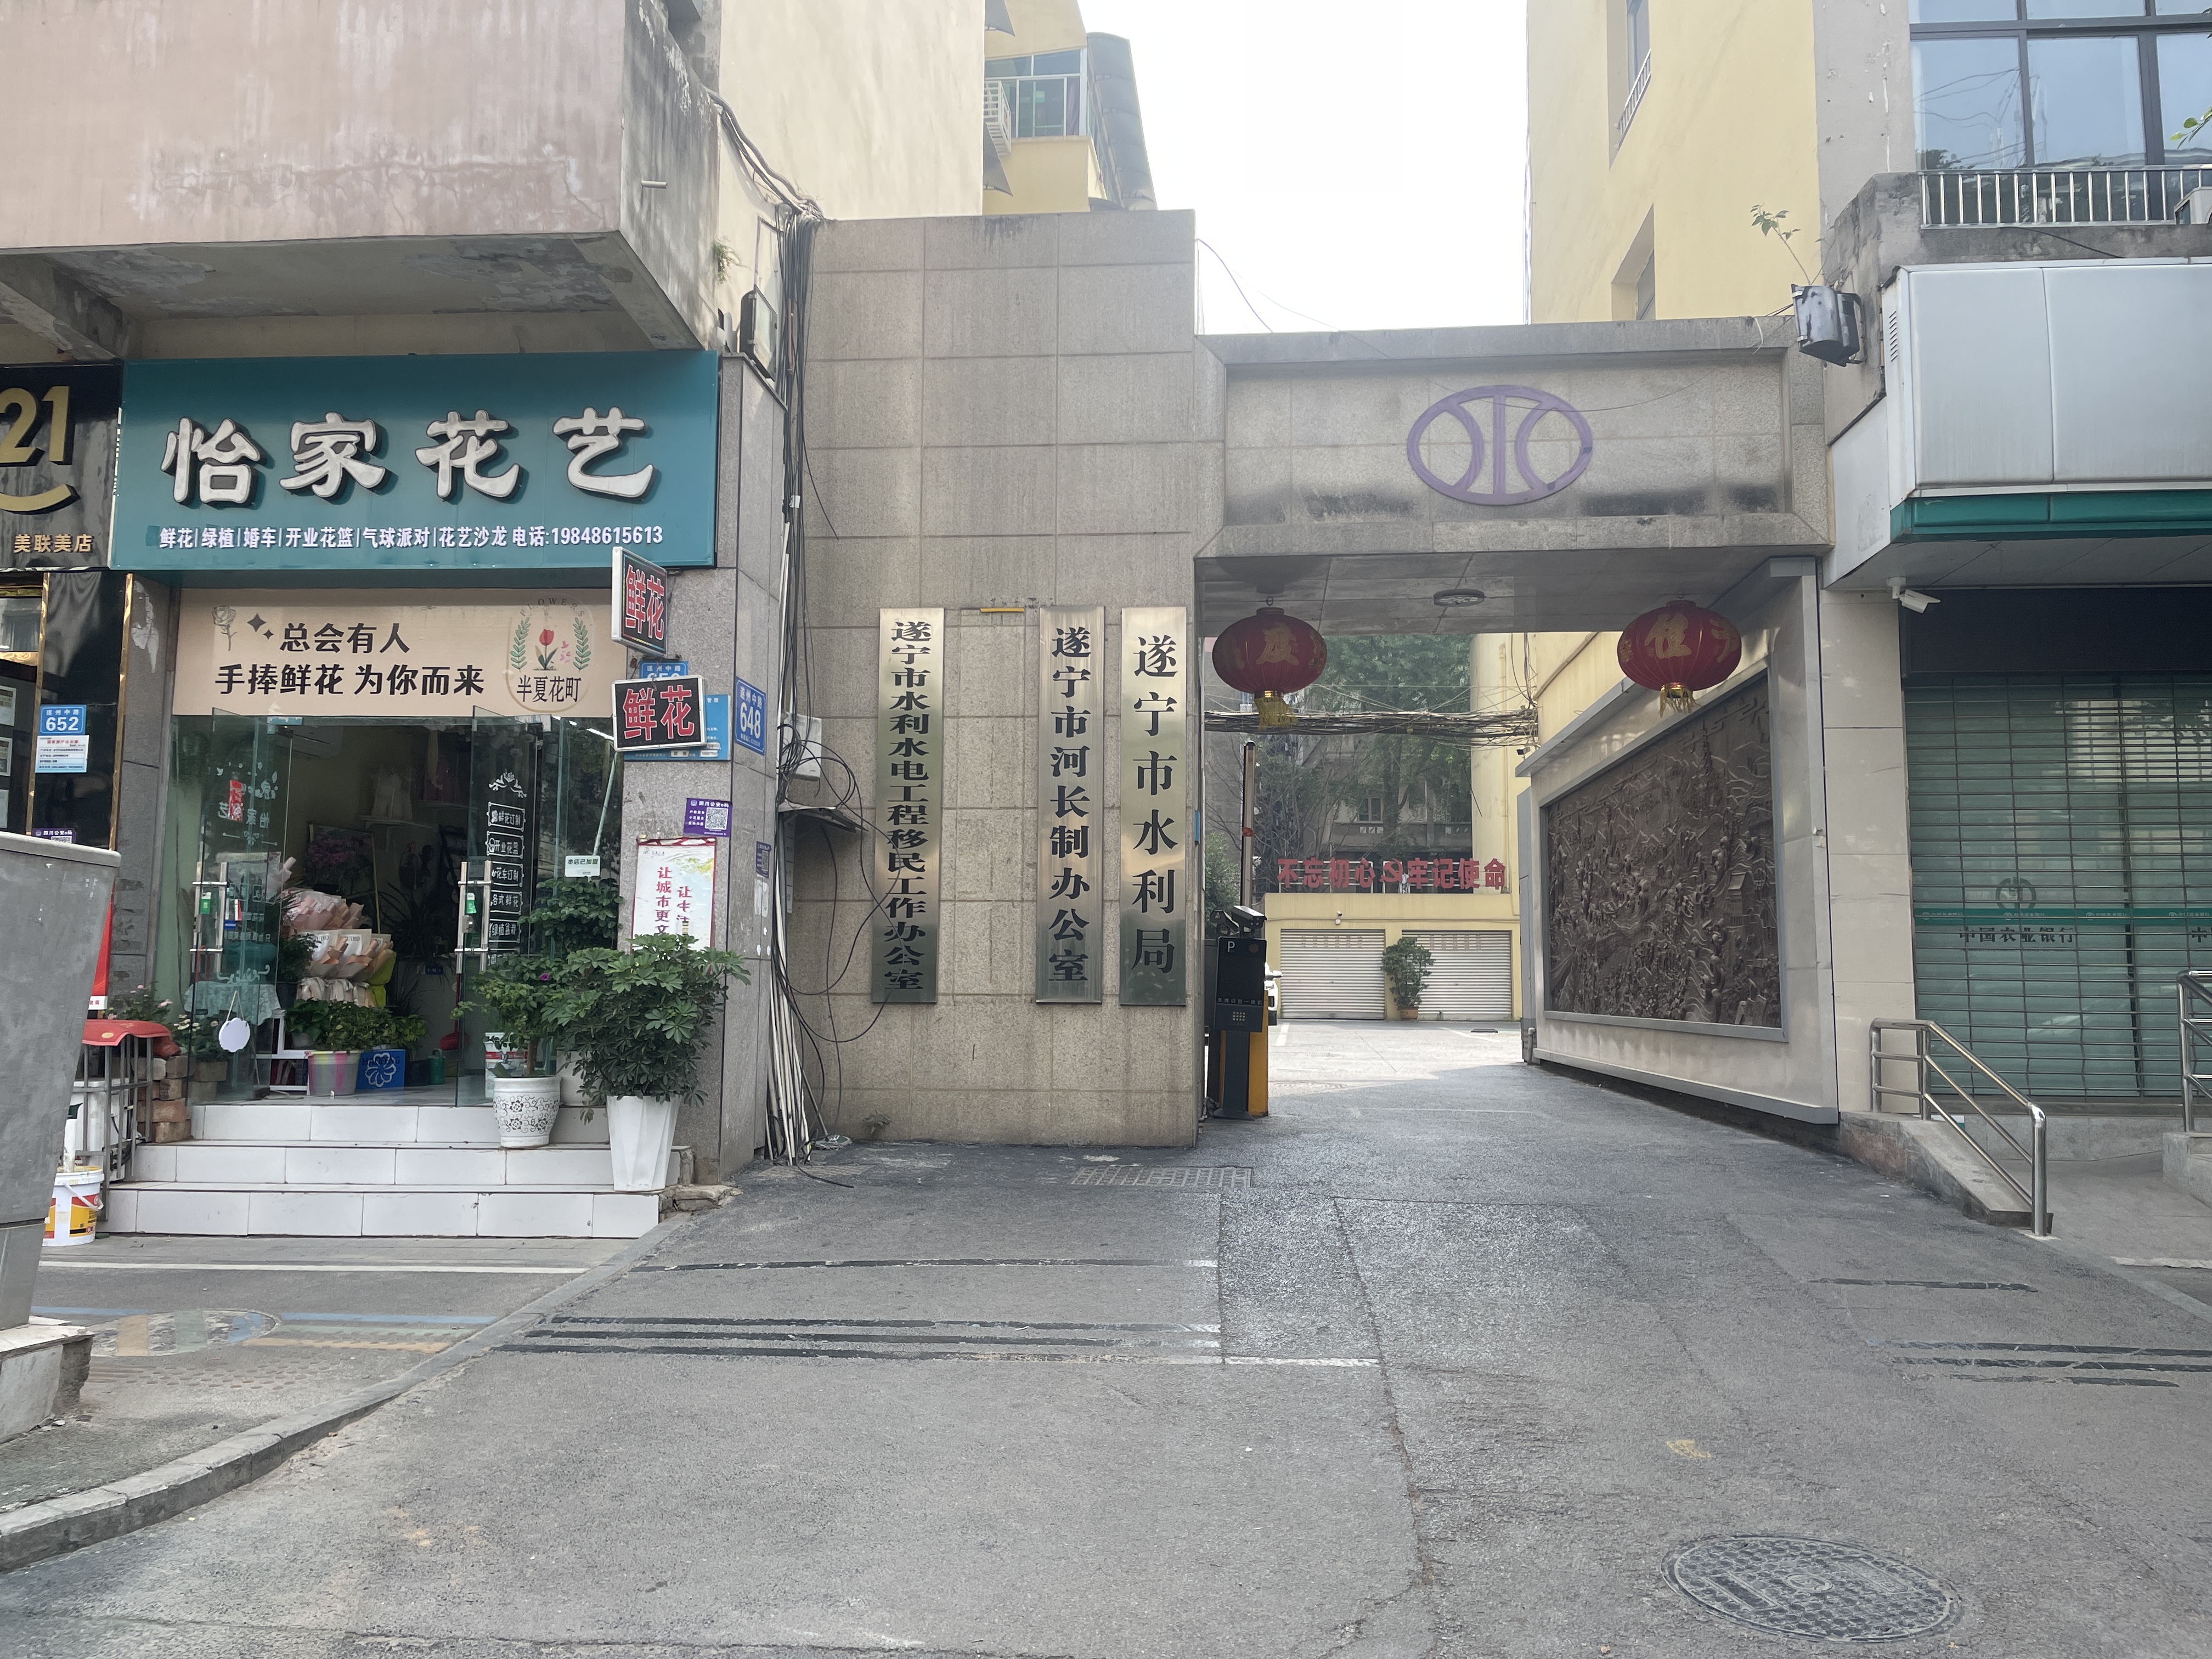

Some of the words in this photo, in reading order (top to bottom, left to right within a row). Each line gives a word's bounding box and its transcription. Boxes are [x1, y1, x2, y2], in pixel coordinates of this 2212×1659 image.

[161, 407, 654, 503] 怡家花艺
[14, 534, 92, 552] 美联美店
[512, 526, 663, 547] 电话:19848615613
[520, 598, 584, 617] FLOWERS
[625, 565, 664, 640] 鲜花
[280, 623, 410, 653] 总会有人
[215, 664, 344, 695] 手捧鲜花
[354, 665, 484, 696] 为你而来
[517, 675, 582, 702] 半夏花町
[46, 716, 79, 731] 652
[623, 685, 695, 741] 鲜花
[740, 702, 761, 739] 648
[883, 622, 932, 990] 遂宁市水利水电工程移民工作办公室
[1048, 627, 1091, 981] 遂宁市河长制办公室
[1131, 635, 1178, 974] 遂宁市水利局
[1277, 857, 1376, 889] 不忘初心
[1407, 857, 1506, 890] 牢记使命
[1227, 941, 1235, 953] P
[1959, 927, 2074, 943] 中国农业银行
